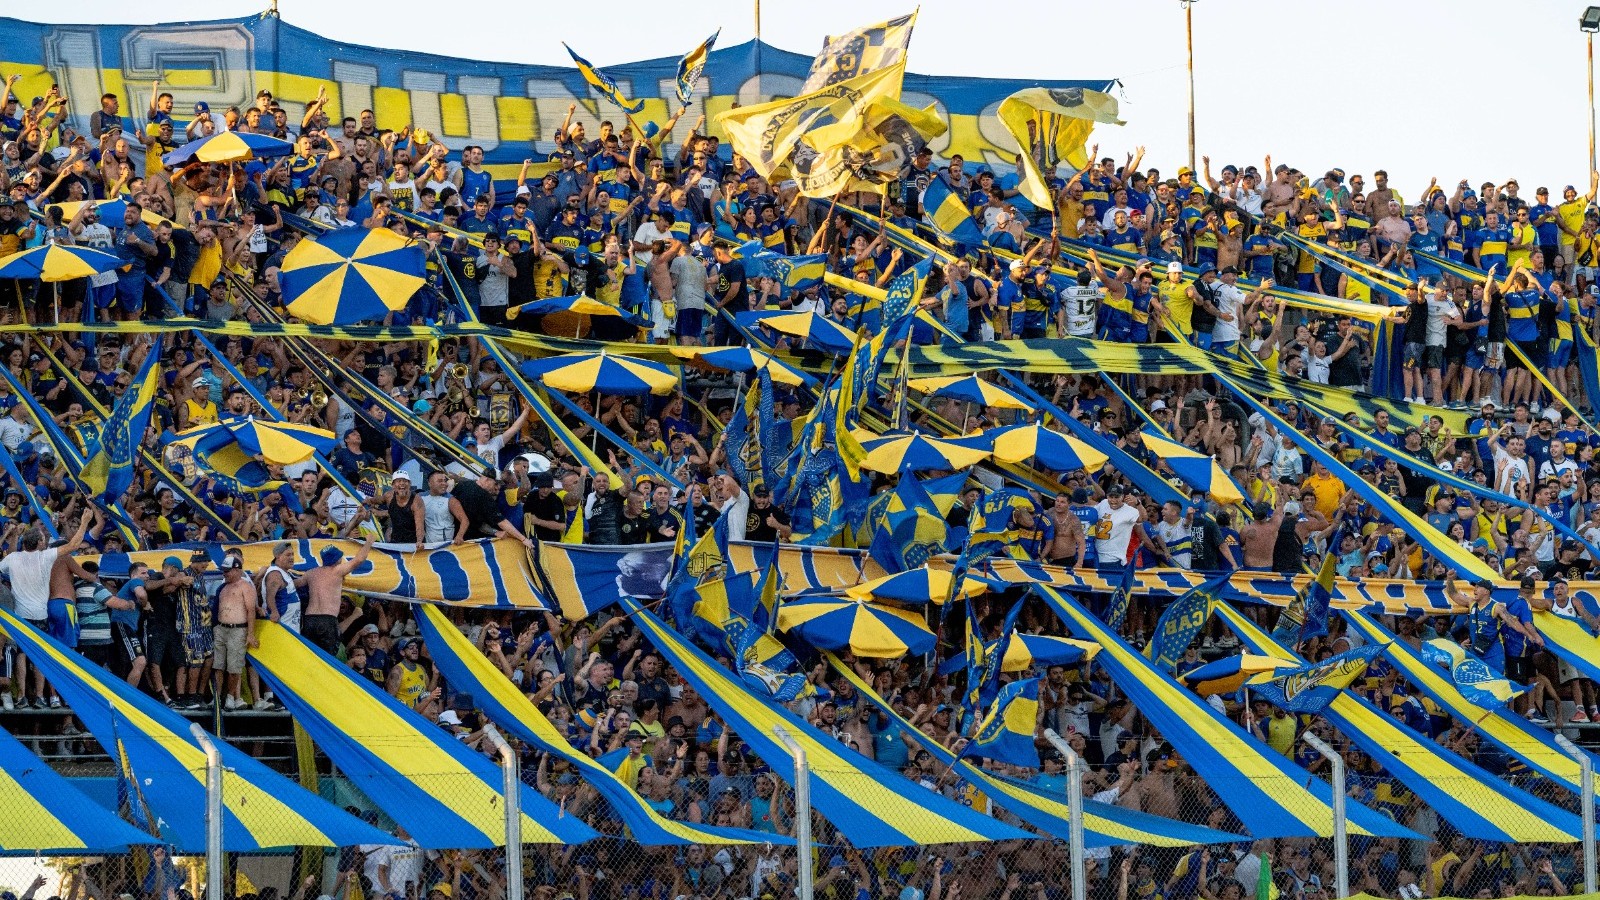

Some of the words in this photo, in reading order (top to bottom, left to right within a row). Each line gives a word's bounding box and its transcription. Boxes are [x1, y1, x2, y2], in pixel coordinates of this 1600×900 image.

[42, 23, 255, 142] 12
[1077, 299, 1097, 316] 12
[491, 408, 509, 424] 12
[1096, 519, 1113, 540] 12
